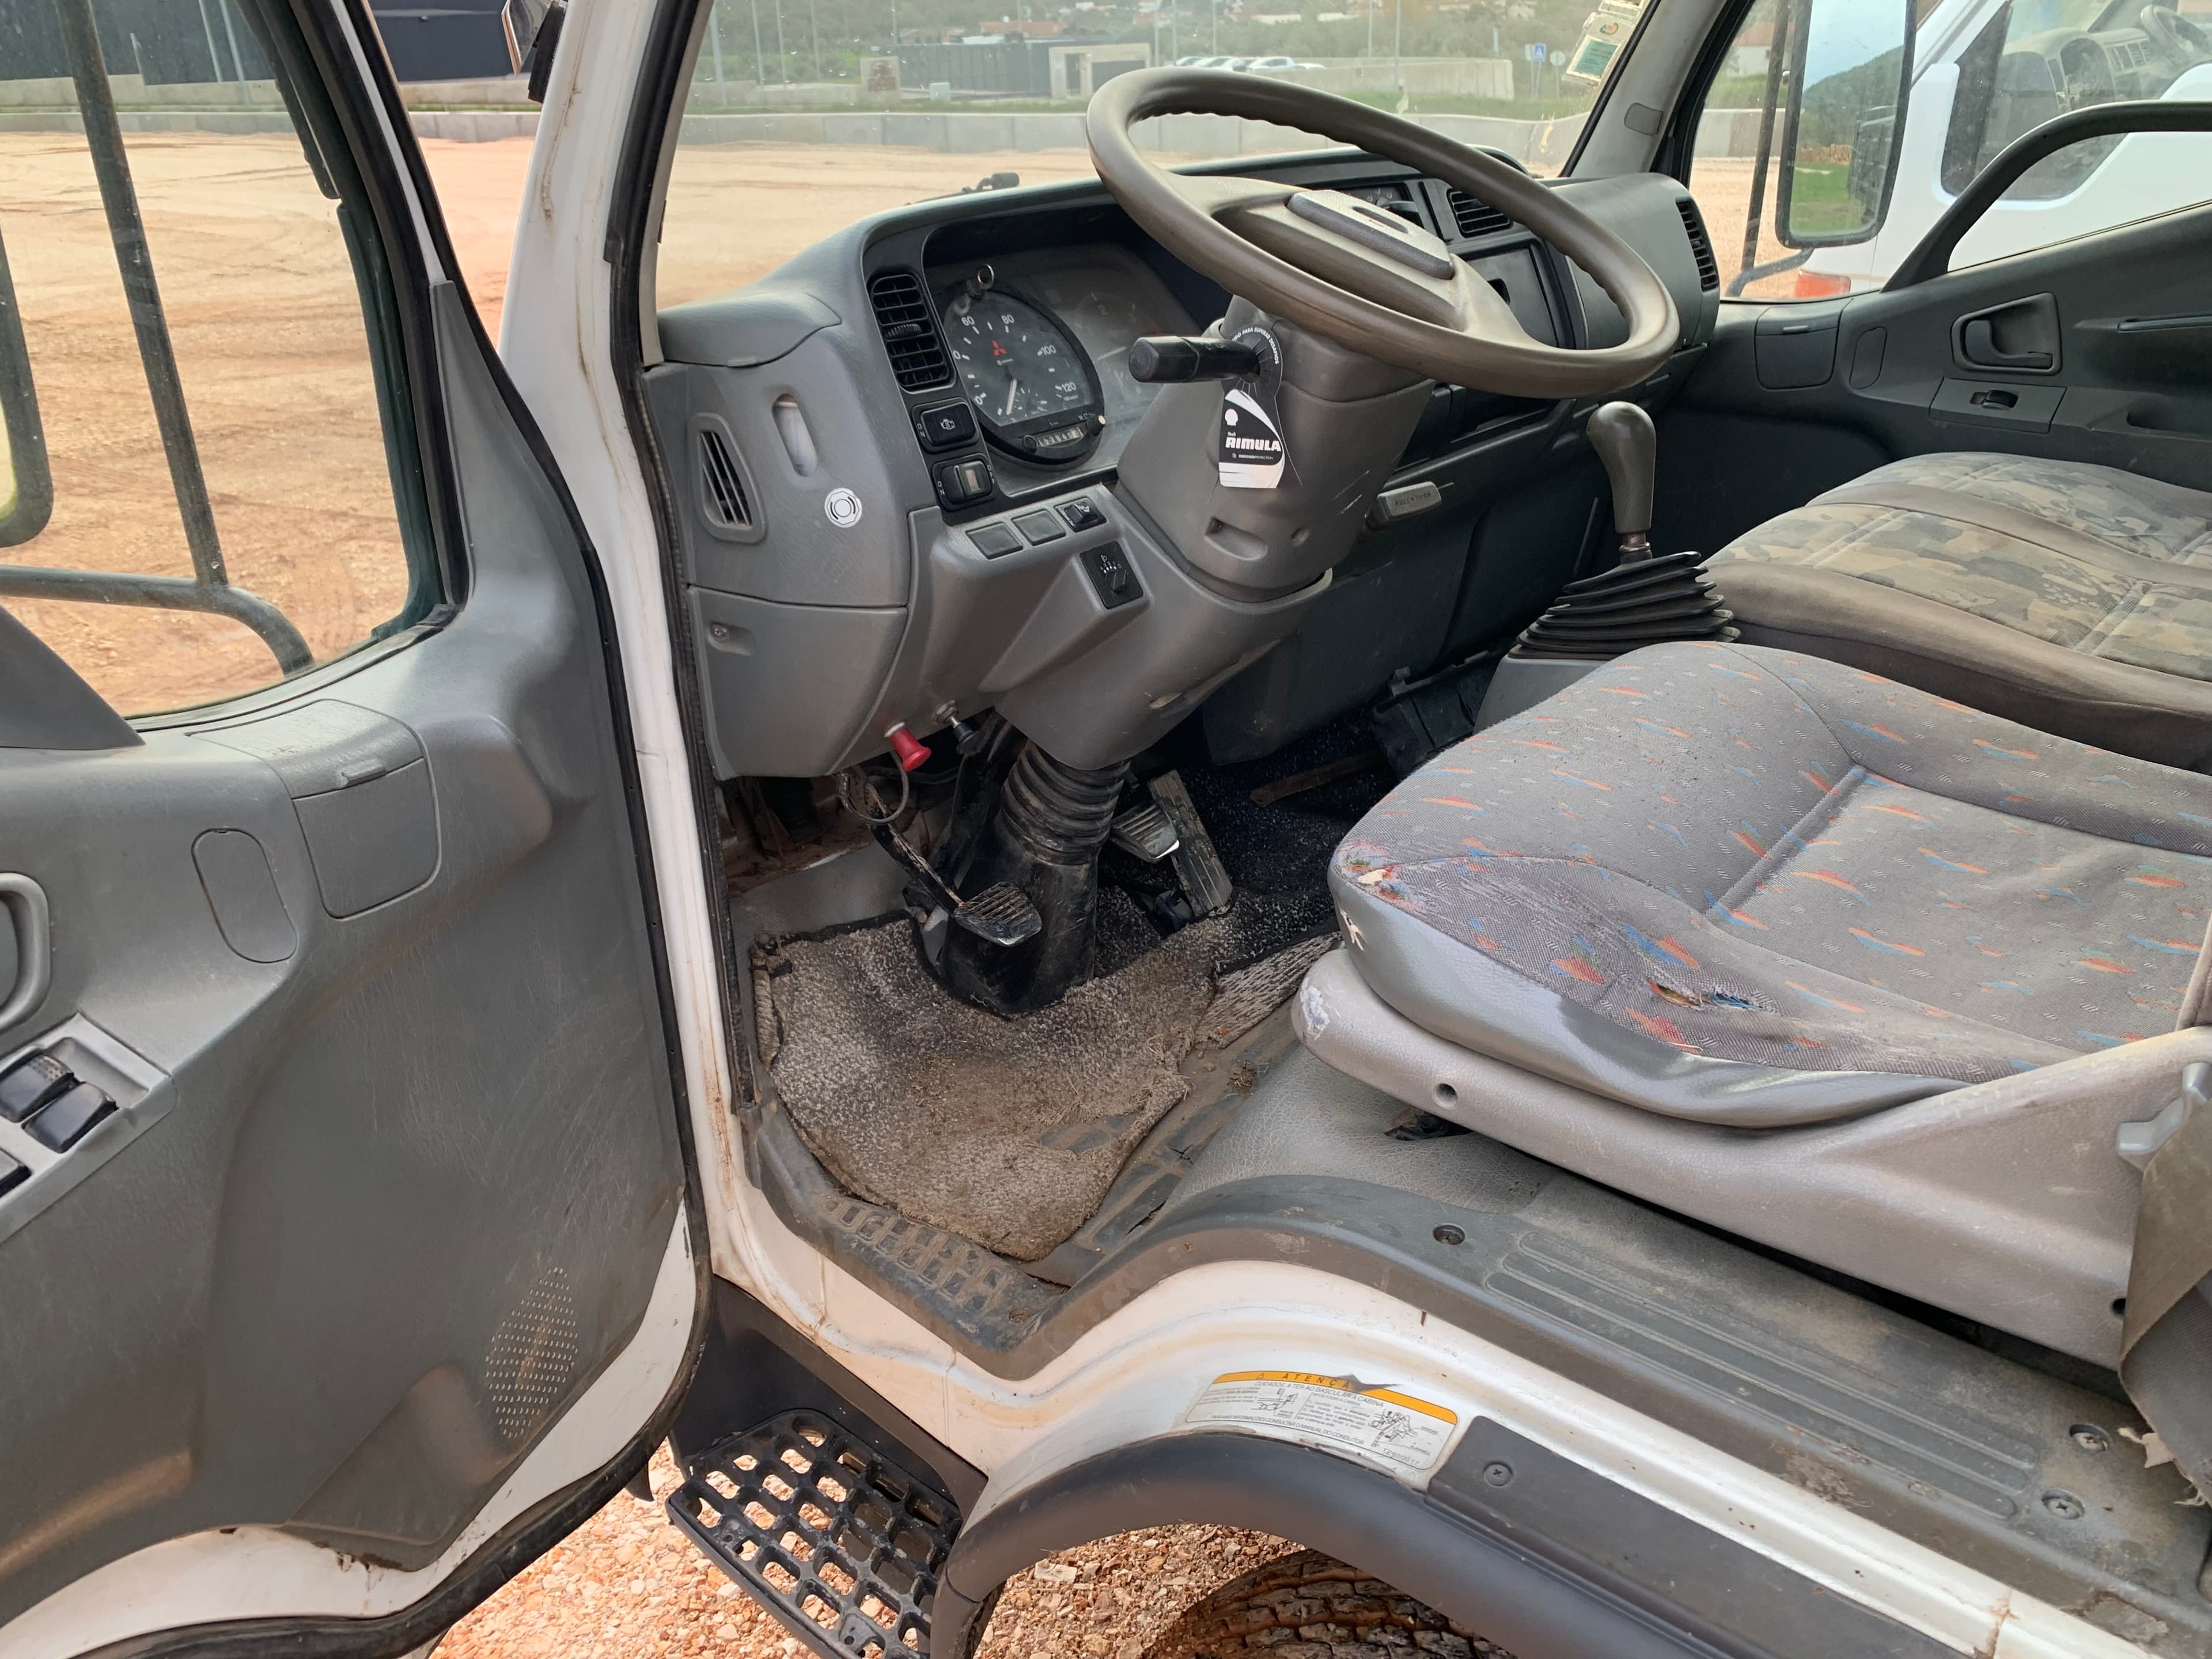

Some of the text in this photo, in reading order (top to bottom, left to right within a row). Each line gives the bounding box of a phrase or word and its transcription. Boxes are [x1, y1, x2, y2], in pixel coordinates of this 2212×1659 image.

[961, 316, 975, 326] 60
[1001, 315, 1014, 324] 80
[1041, 345, 1056, 355] 100
[1254, 327, 1271, 339] SUPERAR
[1268, 338, 1279, 364] DESAFIOS
[1061, 382, 1077, 392] 120
[917, 423, 926, 437] ON
[1225, 437, 1281, 452] RIMULA
[987, 465, 995, 484] OFF
[937, 481, 945, 495] ON
[1316, 1387, 1351, 1400] BASCULAR
[1357, 1395, 1384, 1407] CABINA
[1266, 1418, 1296, 1427] CONSULTAR
[1301, 1423, 1322, 1433] MANUAL
[1332, 1432, 1365, 1445] CONDUTOR
